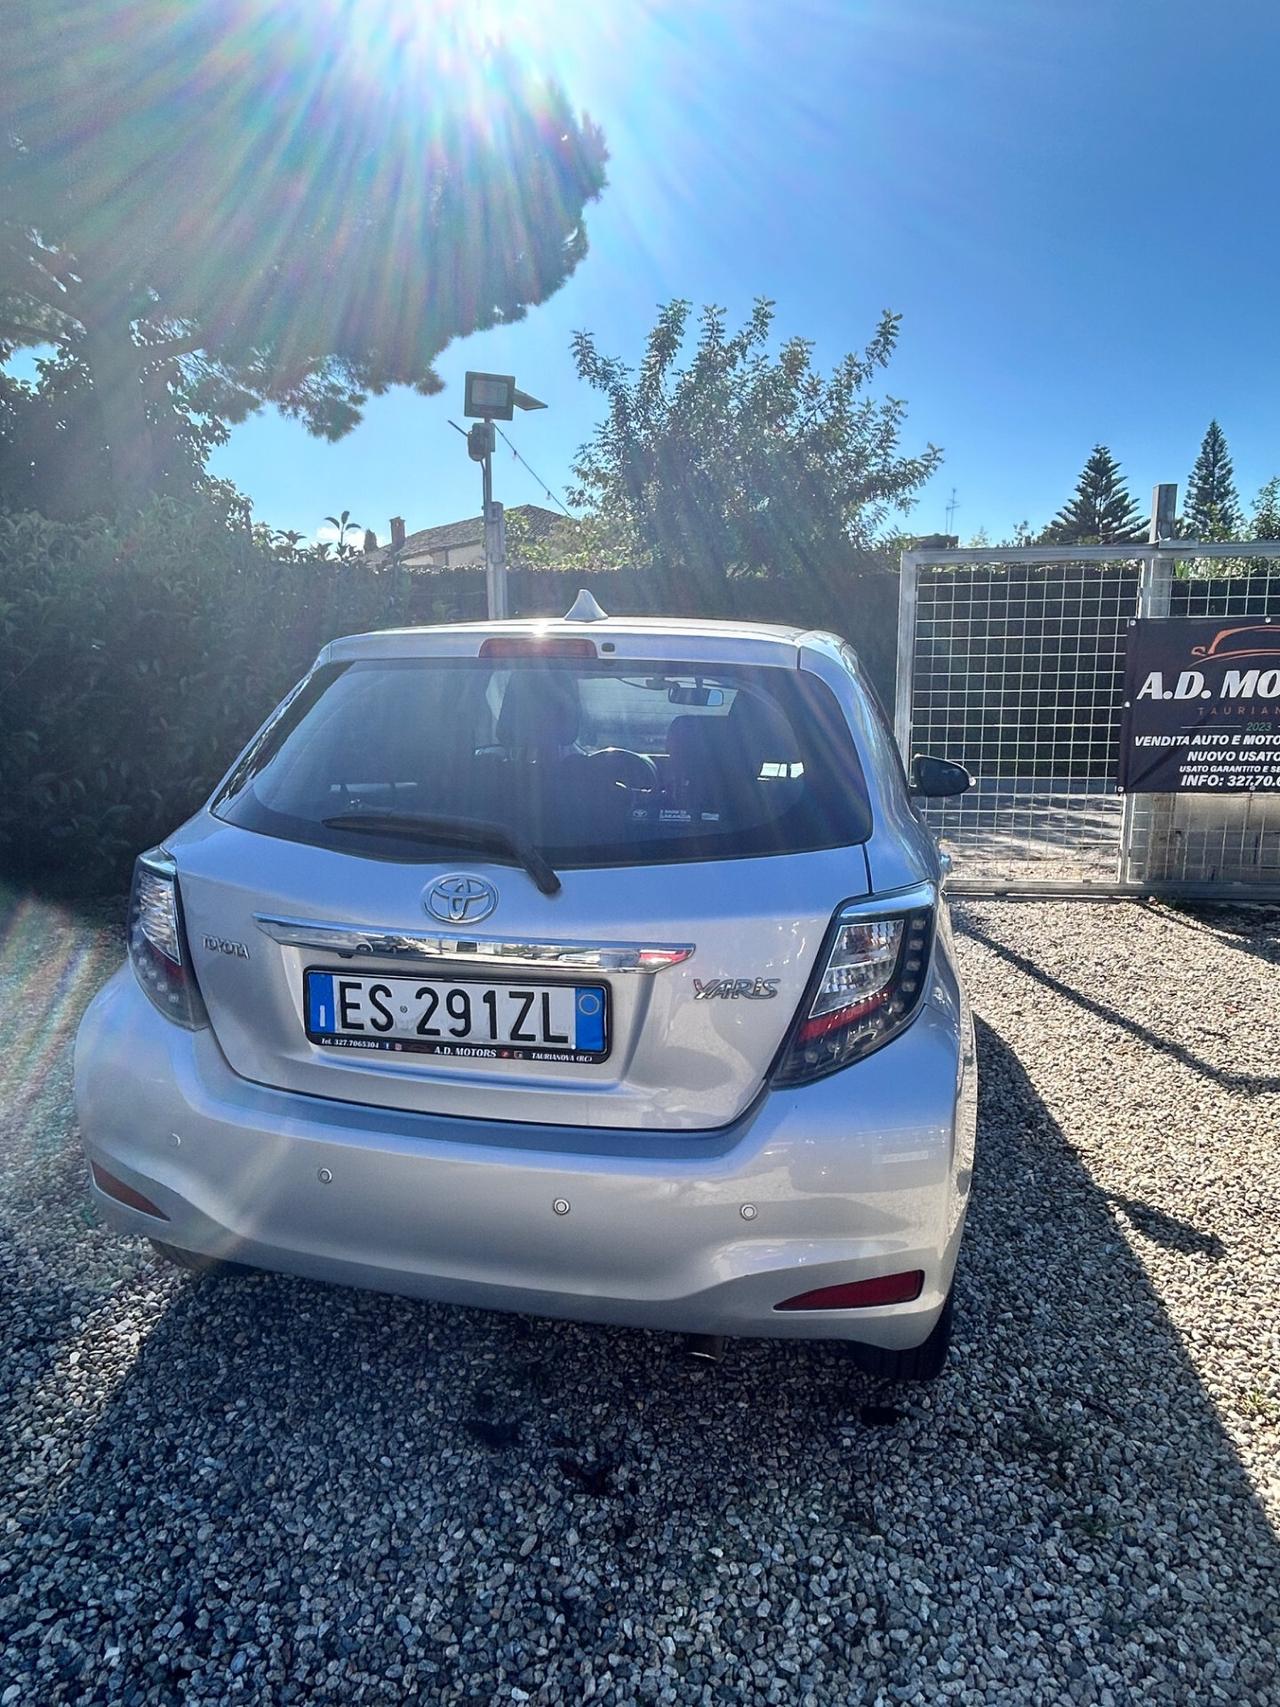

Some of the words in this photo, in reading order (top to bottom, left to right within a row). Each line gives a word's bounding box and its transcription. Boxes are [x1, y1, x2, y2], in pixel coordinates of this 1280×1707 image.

[1136, 670, 1212, 700] A.D.
[1246, 721, 1273, 732] 2023
[1134, 735, 1190, 747] VENDITA
[1191, 734, 1230, 746] AUTO
[1231, 734, 1242, 745] E
[1186, 751, 1236, 762] NUOVO
[1238, 751, 1280, 762] USATO
[1179, 765, 1209, 773] USATO
[1209, 765, 1262, 773] GARANTITO
[1262, 765, 1270, 773] E
[1180, 774, 1225, 787] INFO:
[201, 934, 250, 960] TOYOTA
[339, 981, 395, 1032] ES
[434, 1045, 454, 1056] A.D.
[455, 1047, 497, 1058] MOTORS
